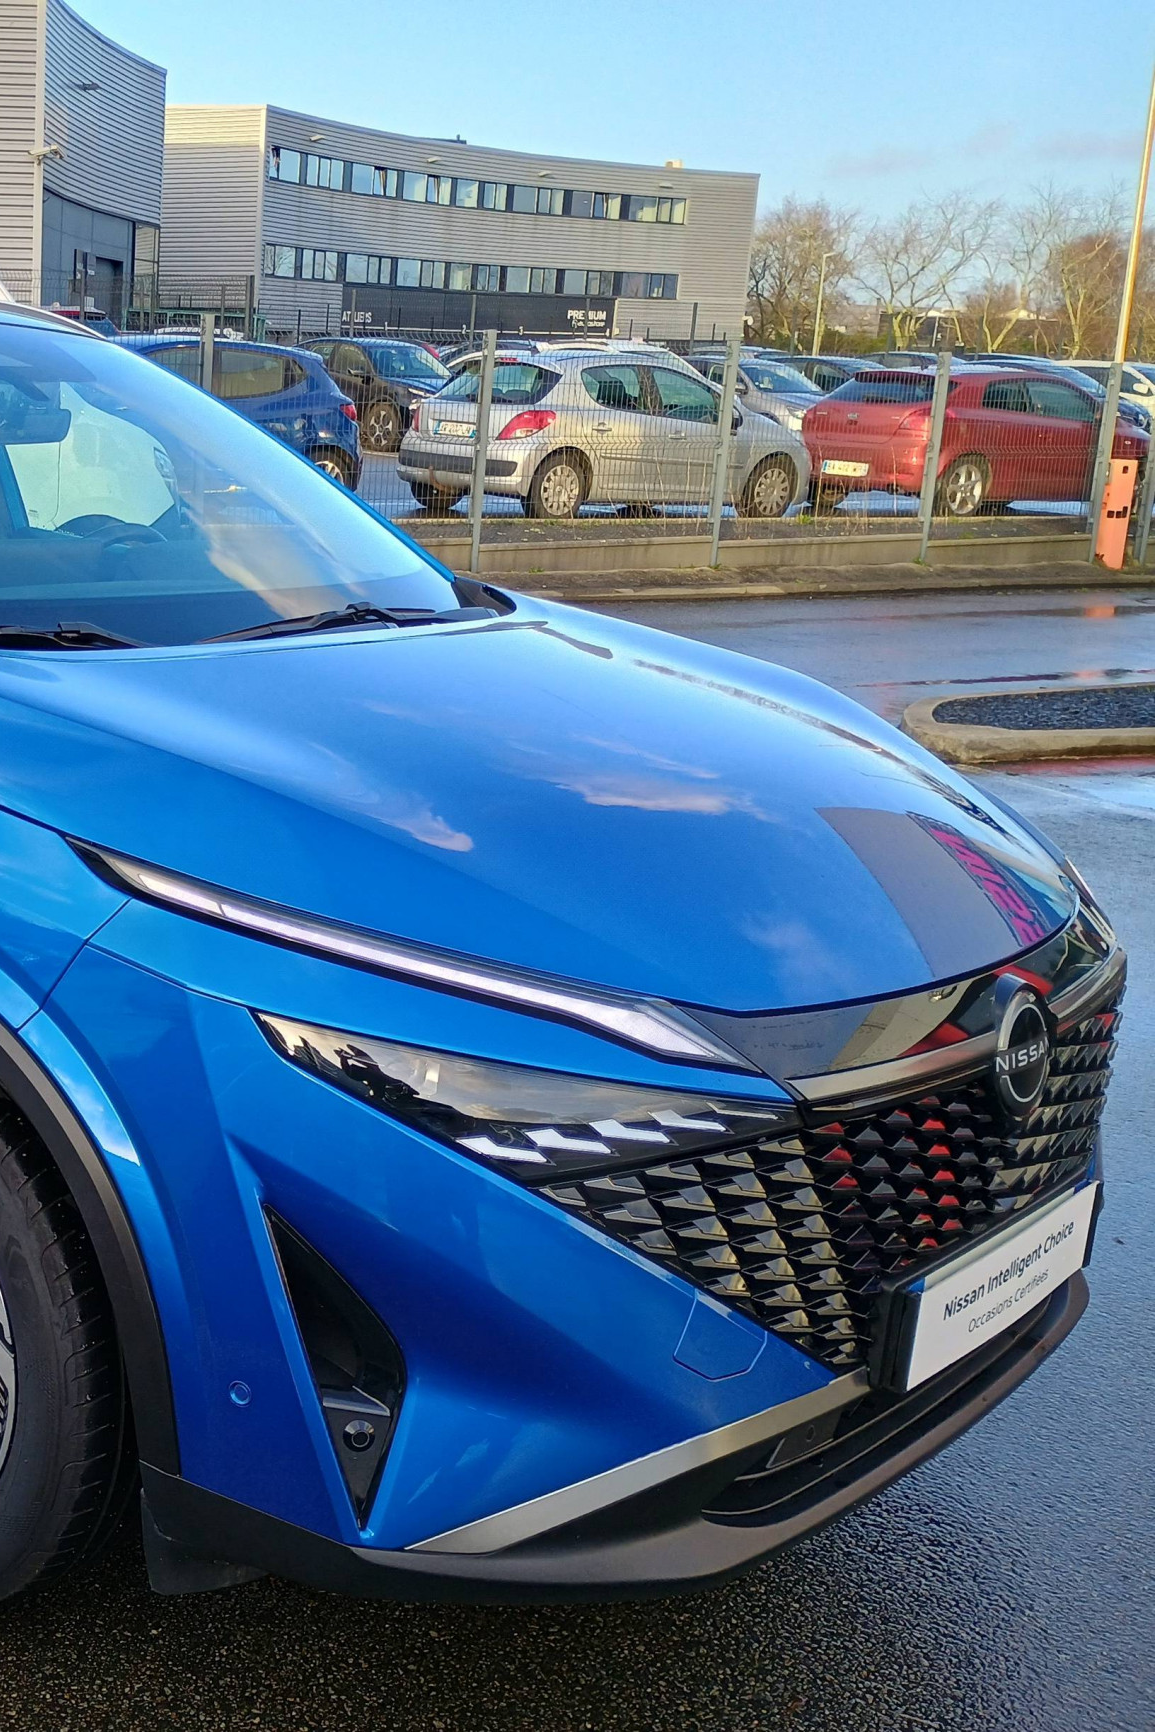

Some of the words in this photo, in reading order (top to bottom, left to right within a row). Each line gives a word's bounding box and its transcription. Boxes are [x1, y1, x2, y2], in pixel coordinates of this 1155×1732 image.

[342, 311, 372, 323] ATLIES
[995, 1036, 1049, 1073] NISSA
[943, 1284, 985, 1321] Nissan
[987, 1243, 1043, 1294] Intelligent
[1043, 1221, 1074, 1255] Choice
[968, 1296, 1013, 1333] Occasions
